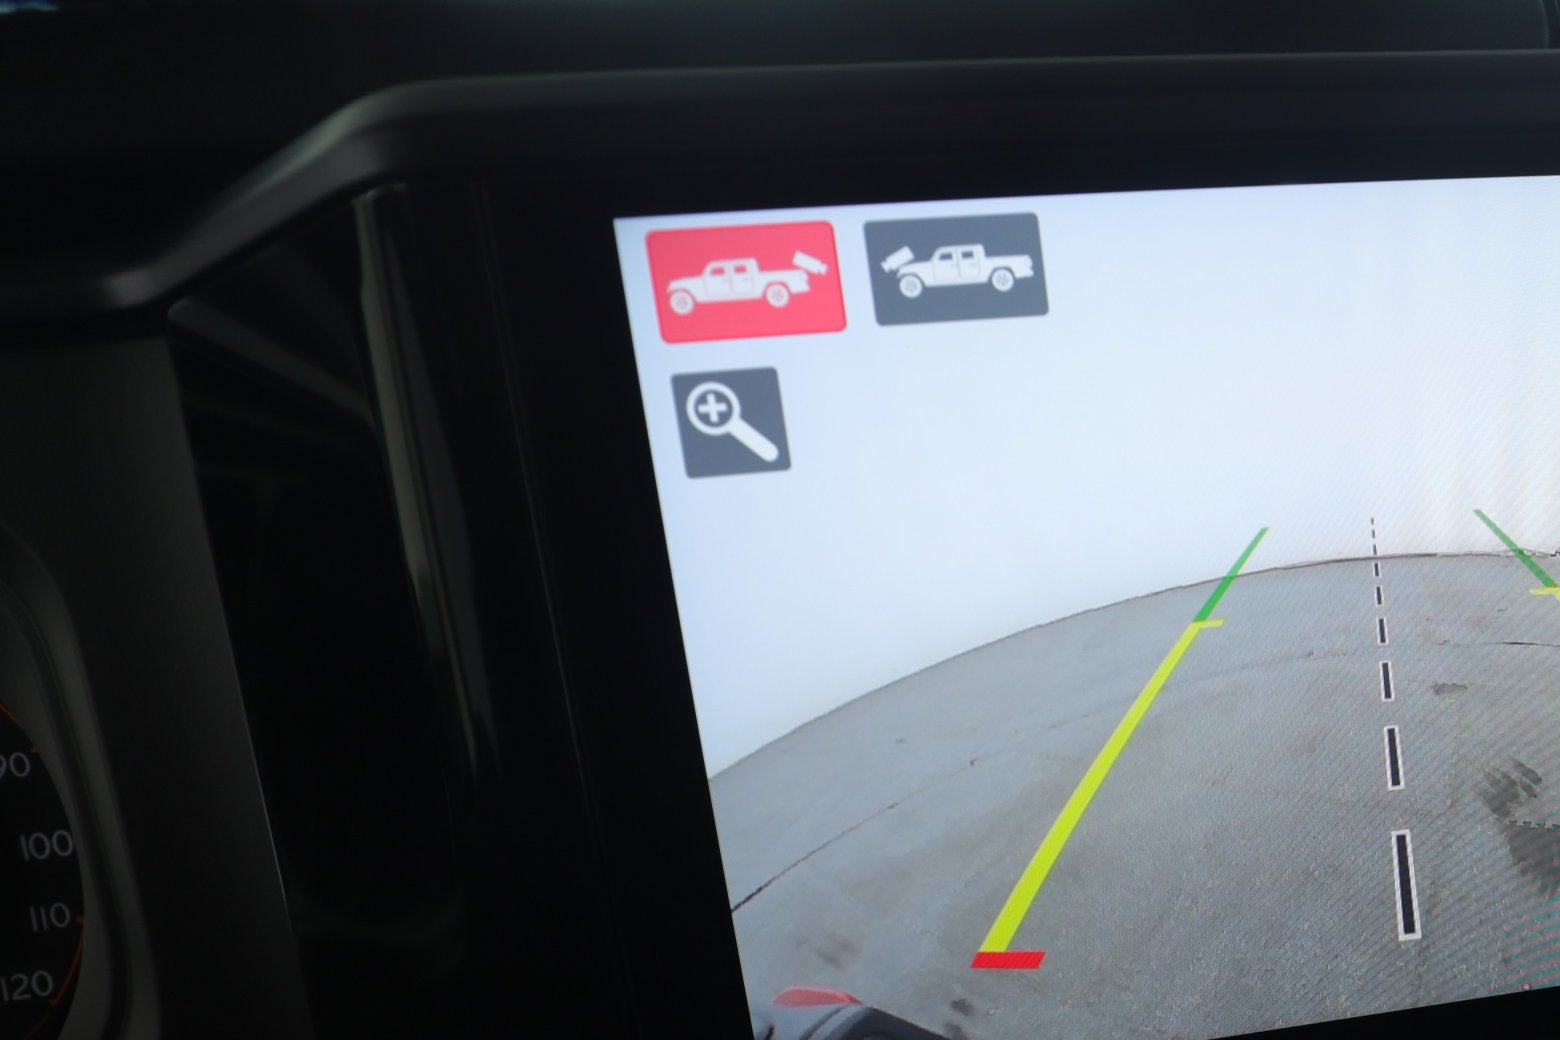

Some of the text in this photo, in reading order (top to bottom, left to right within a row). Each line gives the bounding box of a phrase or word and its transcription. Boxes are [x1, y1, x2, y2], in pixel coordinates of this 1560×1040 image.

[19, 829, 74, 863] 100
[29, 902, 71, 933] 110
[0, 970, 54, 1001] 120
